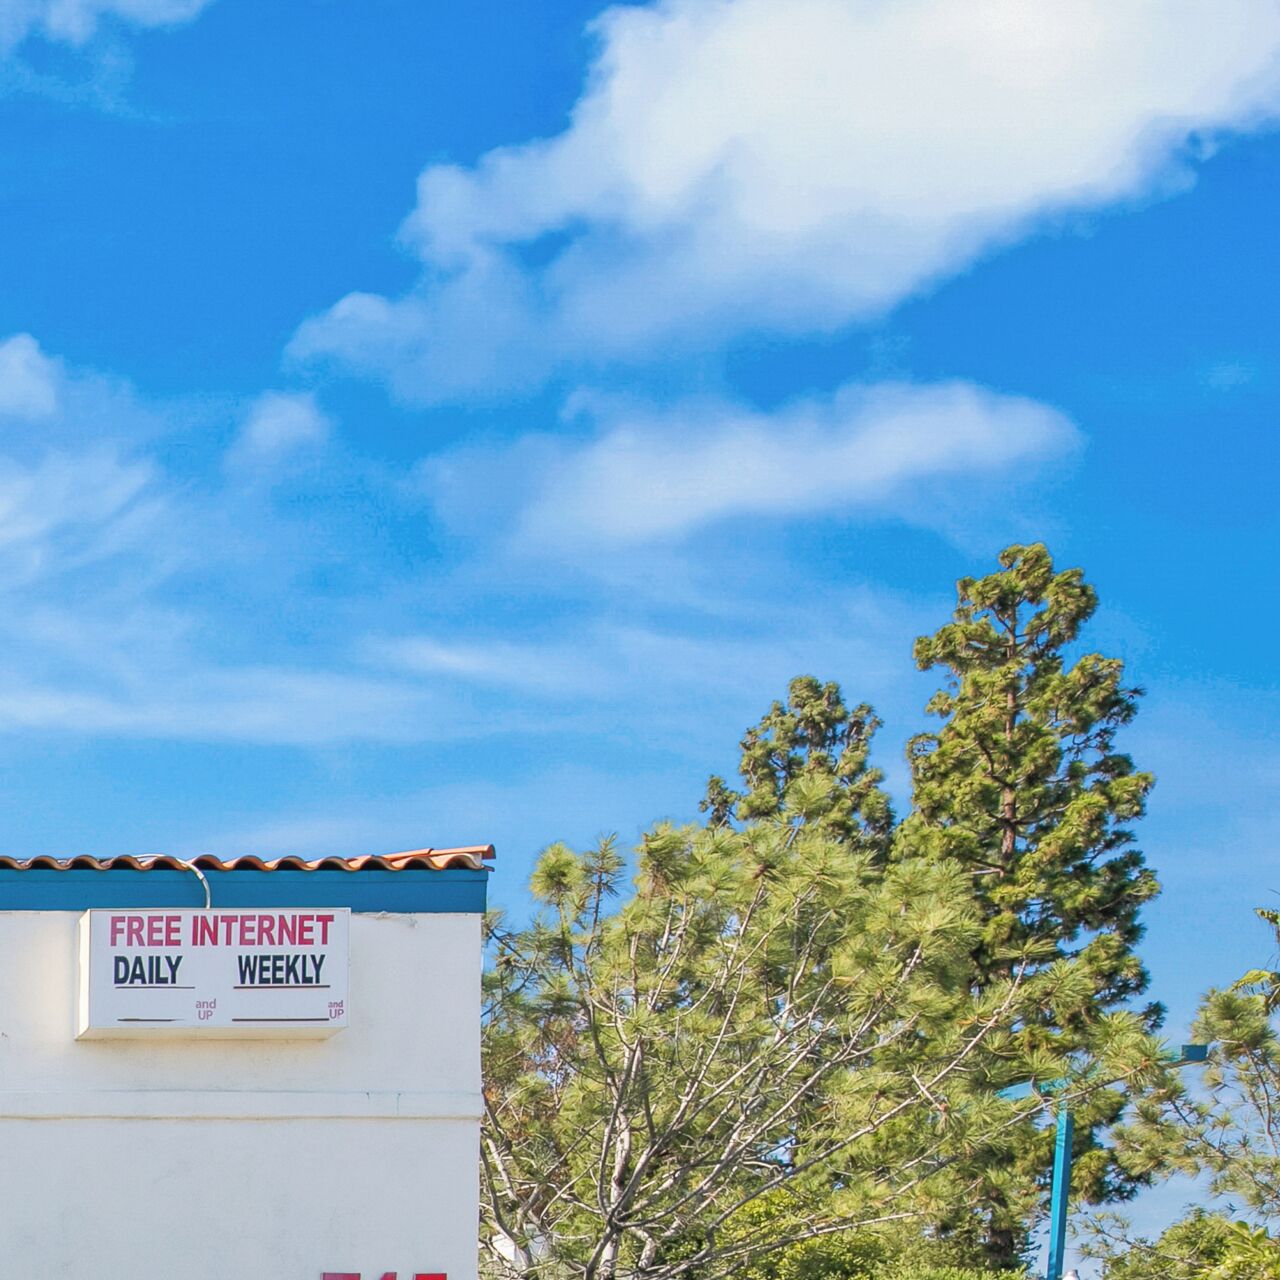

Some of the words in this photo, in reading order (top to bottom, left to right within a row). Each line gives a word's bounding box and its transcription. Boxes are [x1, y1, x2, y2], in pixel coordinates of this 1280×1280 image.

[110, 915, 182, 946] FREE
[192, 914, 335, 945] INTERNET
[114, 955, 183, 985] DAILY
[237, 954, 326, 985] WEEKLY
[195, 998, 217, 1010] and
[328, 1000, 344, 1009] and
[198, 1010, 213, 1020] UP
[329, 1009, 344, 1019] UP
